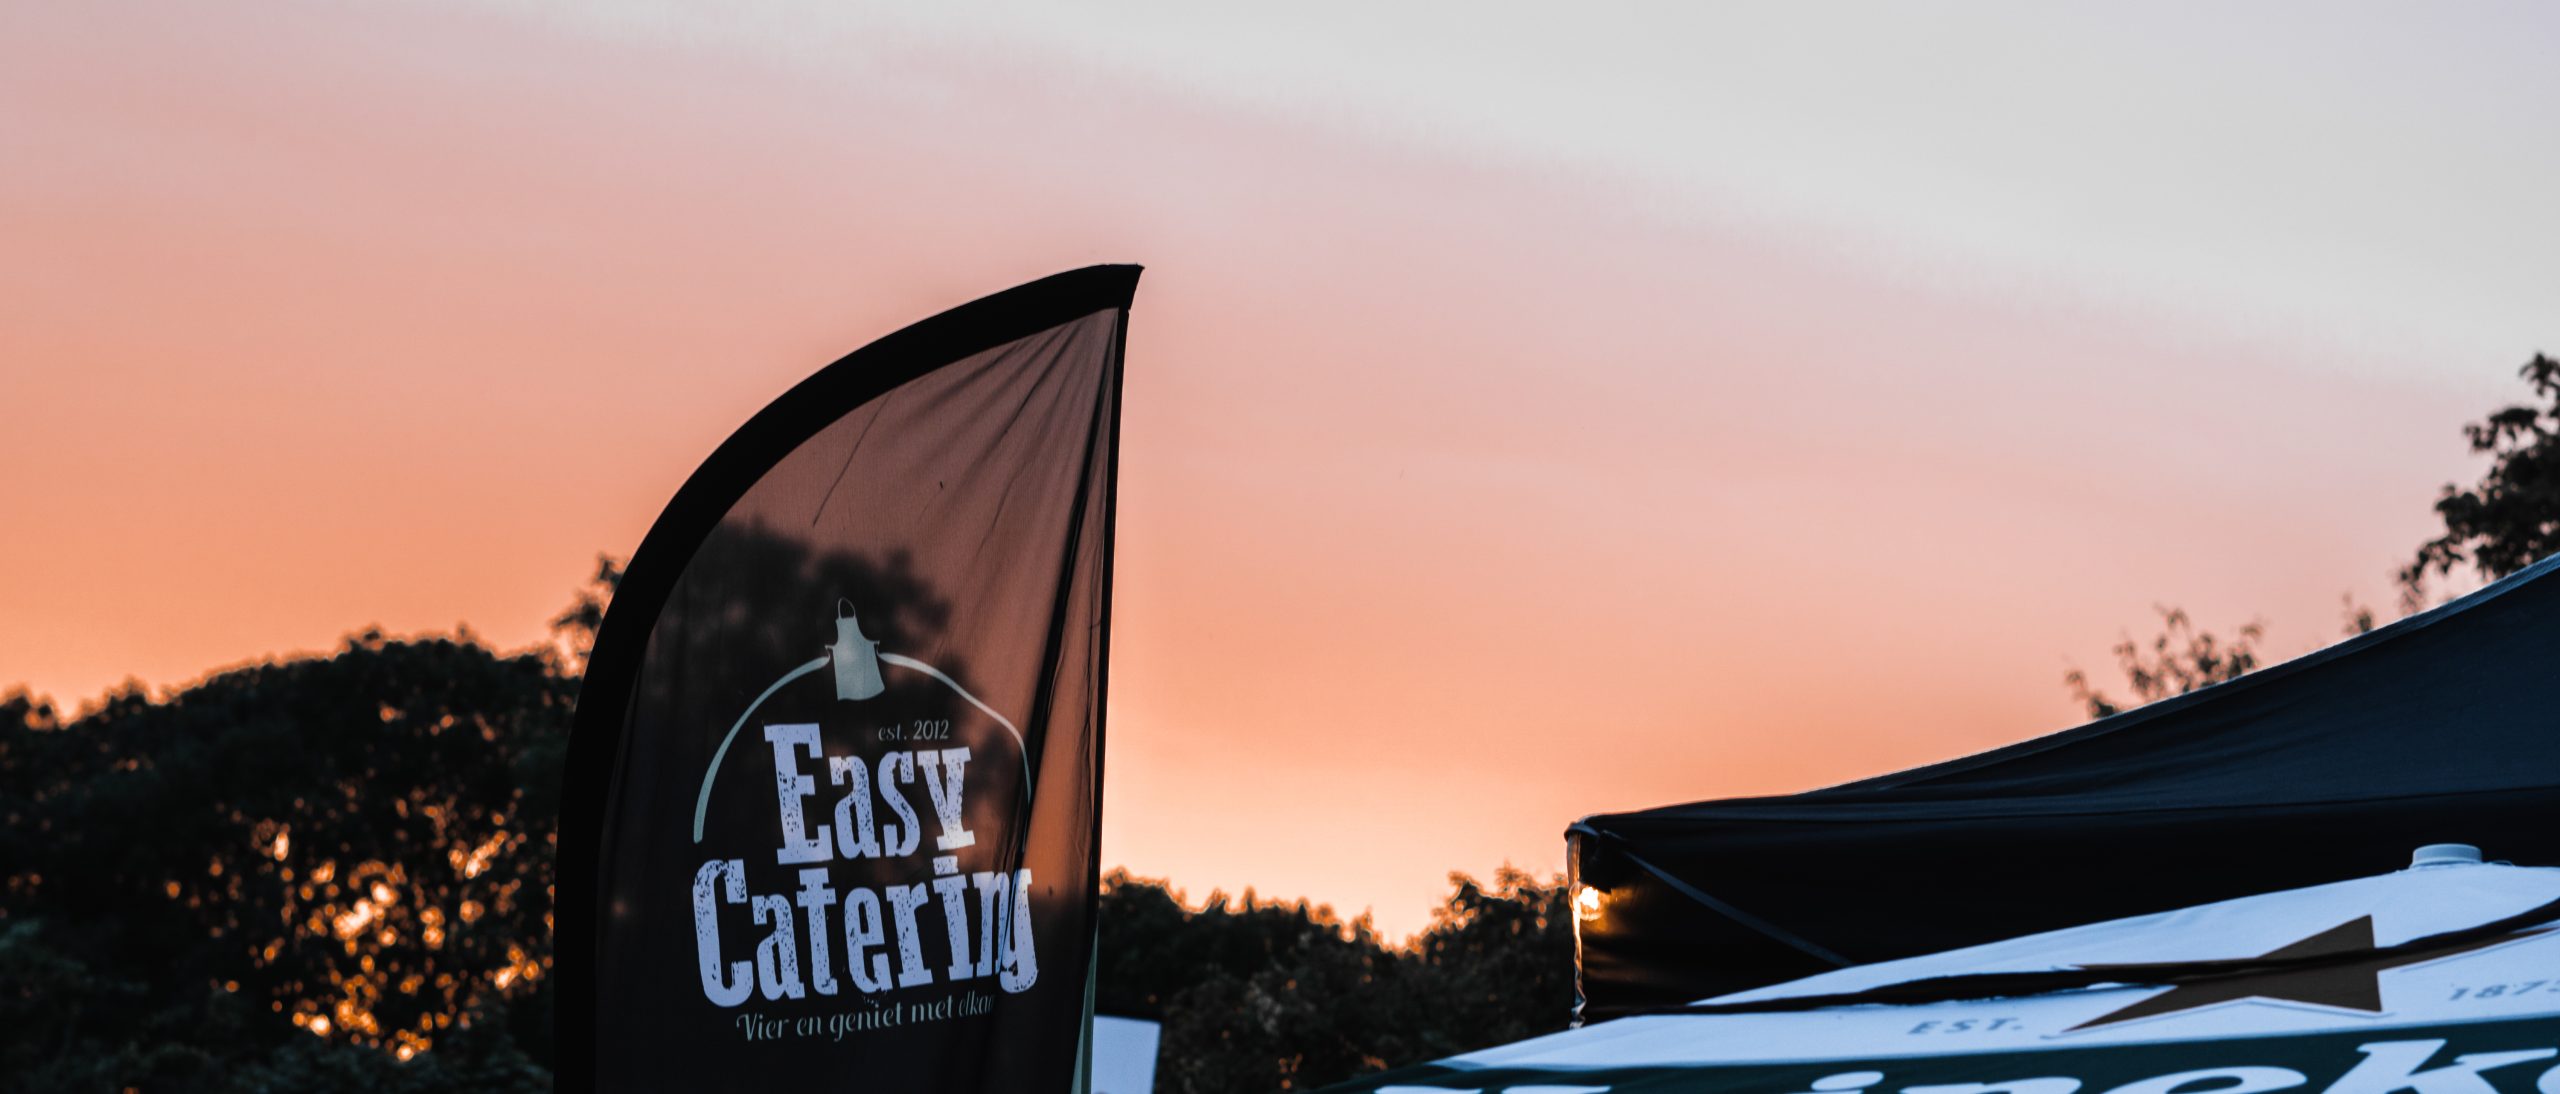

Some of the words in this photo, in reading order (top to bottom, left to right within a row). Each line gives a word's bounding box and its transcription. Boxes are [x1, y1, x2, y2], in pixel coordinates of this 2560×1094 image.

[878, 722, 907, 741] est.
[912, 719, 949, 741] 2012
[764, 722, 976, 865] Easy
[692, 855, 1039, 1008] Catering
[736, 1013, 790, 1042] Vier
[796, 1015, 822, 1037] en
[829, 1001, 903, 1042] geniet
[911, 995, 953, 1024] met
[1907, 1016, 2024, 1036] EST.
